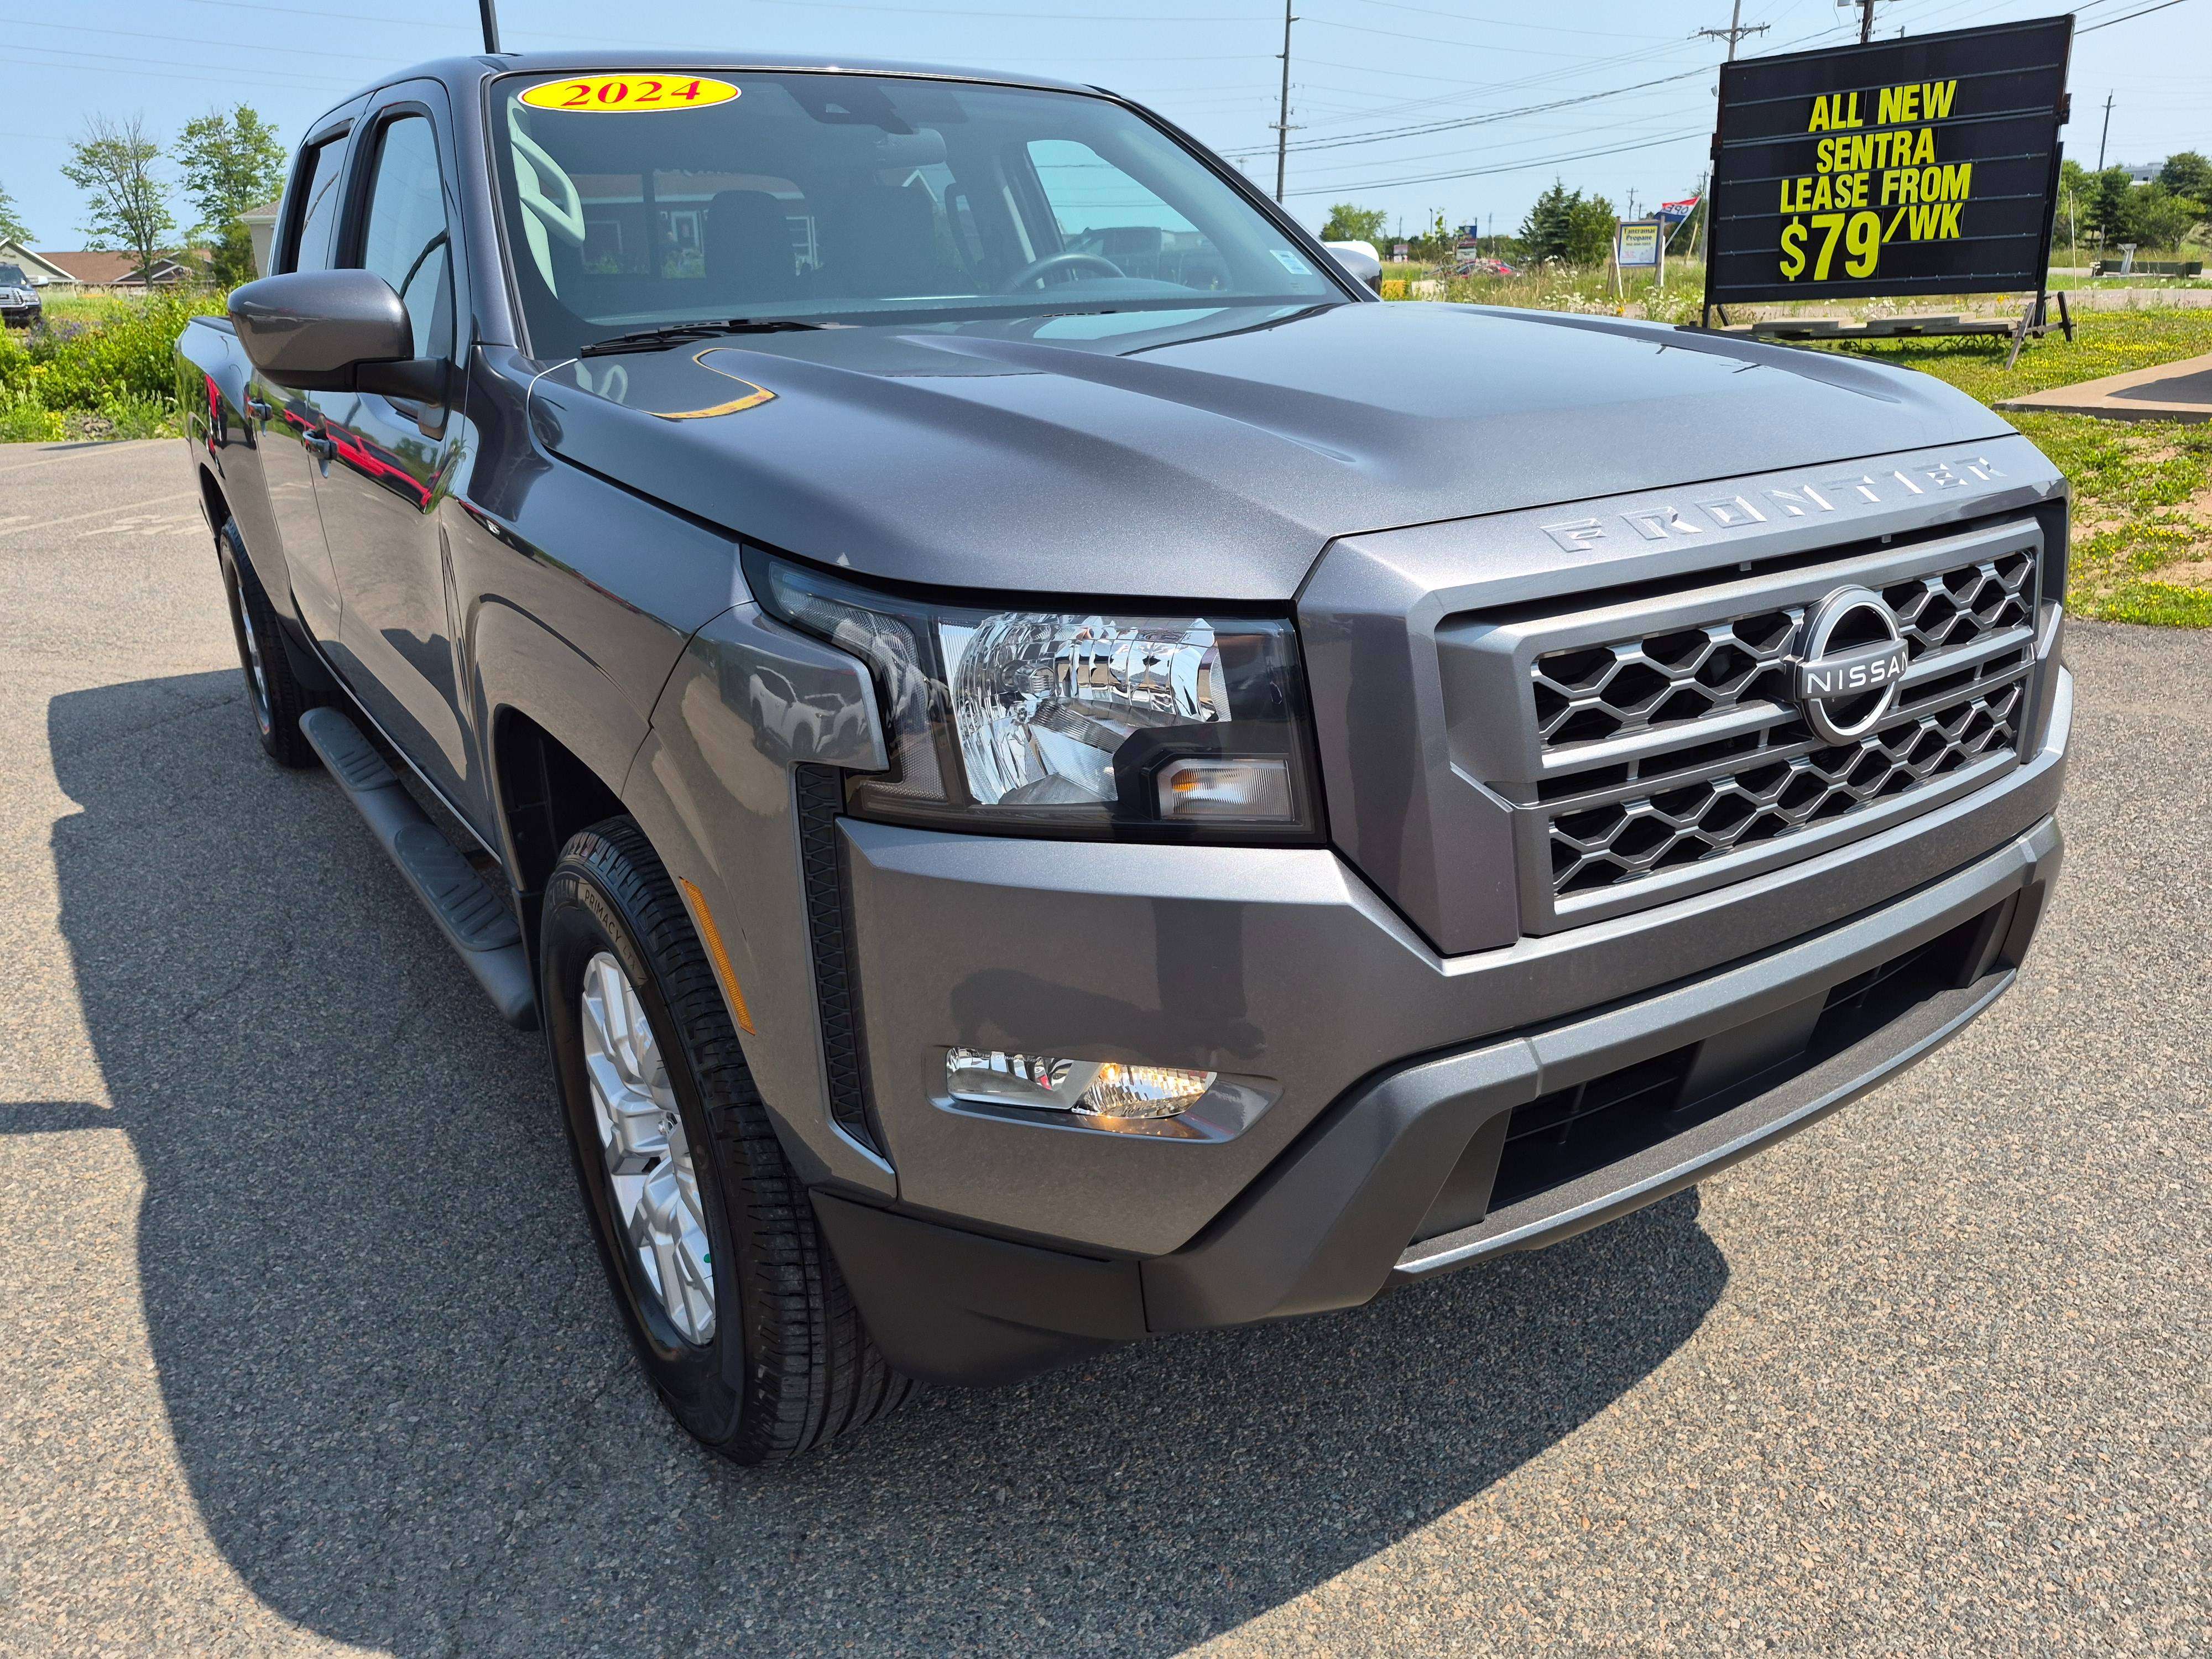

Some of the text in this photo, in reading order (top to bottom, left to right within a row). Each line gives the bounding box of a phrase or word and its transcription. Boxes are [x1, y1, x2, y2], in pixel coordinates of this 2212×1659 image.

[560, 80, 701, 106] 2024
[1808, 79, 1958, 132] ALL NEW
[1815, 127, 1936, 174] SENTRA
[1780, 162, 1973, 213] LEASE FROM
[1539, 456, 2008, 552] FRONTIER
[1807, 650, 1908, 694] NISSAN
[584, 889, 637, 971] PRIMACY LTX
